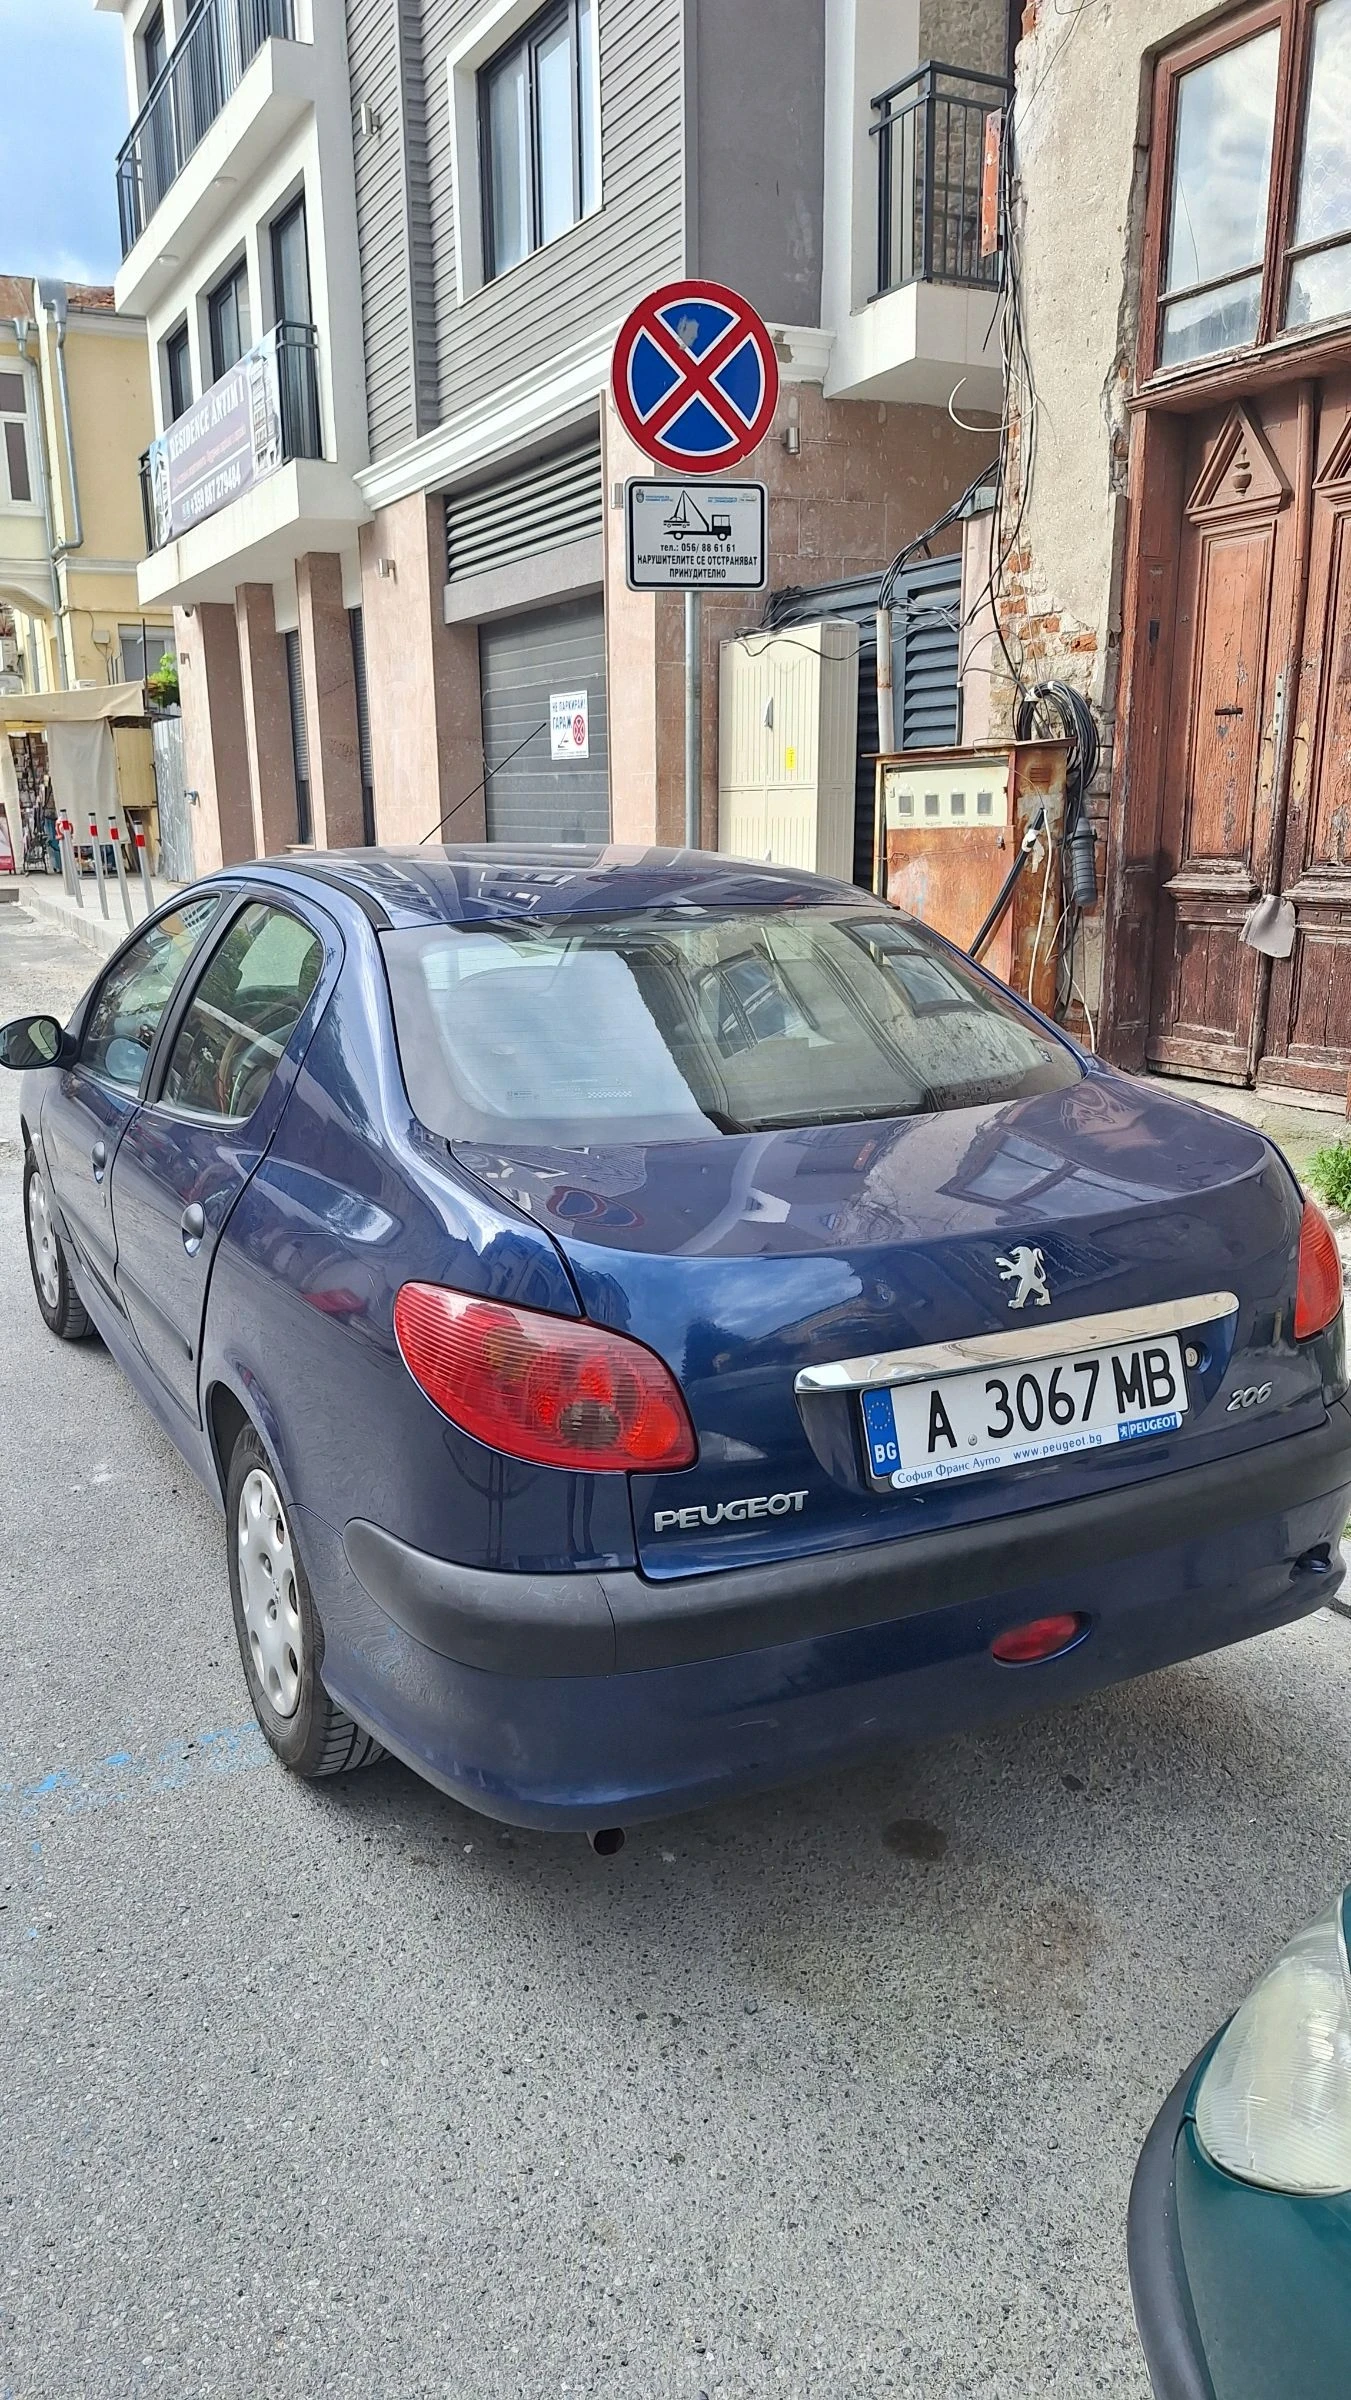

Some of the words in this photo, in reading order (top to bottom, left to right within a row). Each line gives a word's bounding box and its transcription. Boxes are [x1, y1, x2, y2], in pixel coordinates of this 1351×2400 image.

[170, 410, 211, 463] RESIDENCE
[190, 486, 204, 516] +359
[637, 554, 695, 566] НАРУШИТЕЛИТЕ
[696, 555, 706, 566] СЕ
[707, 555, 758, 566] ОТСТРАНЯВАТ
[681, 543, 700, 553] 056/
[701, 543, 712, 552] 88
[714, 543, 724, 552] 61
[726, 543, 736, 552] 61
[669, 568, 726, 580] ПРИНУДИТЕЛНО
[927, 1389, 957, 1453] A
[985, 1359, 1100, 1439] 3067
[1111, 1348, 1176, 1414] MB
[1225, 1381, 1273, 1412] 206
[1130, 1414, 1177, 1435] PEUGEOT
[874, 1442, 897, 1463] BG
[1013, 1433, 1102, 1460] www.peugeot.bg
[897, 1469, 933, 1484] София
[935, 1461, 970, 1477] Франс
[654, 1490, 809, 1533] PEUGEOT
